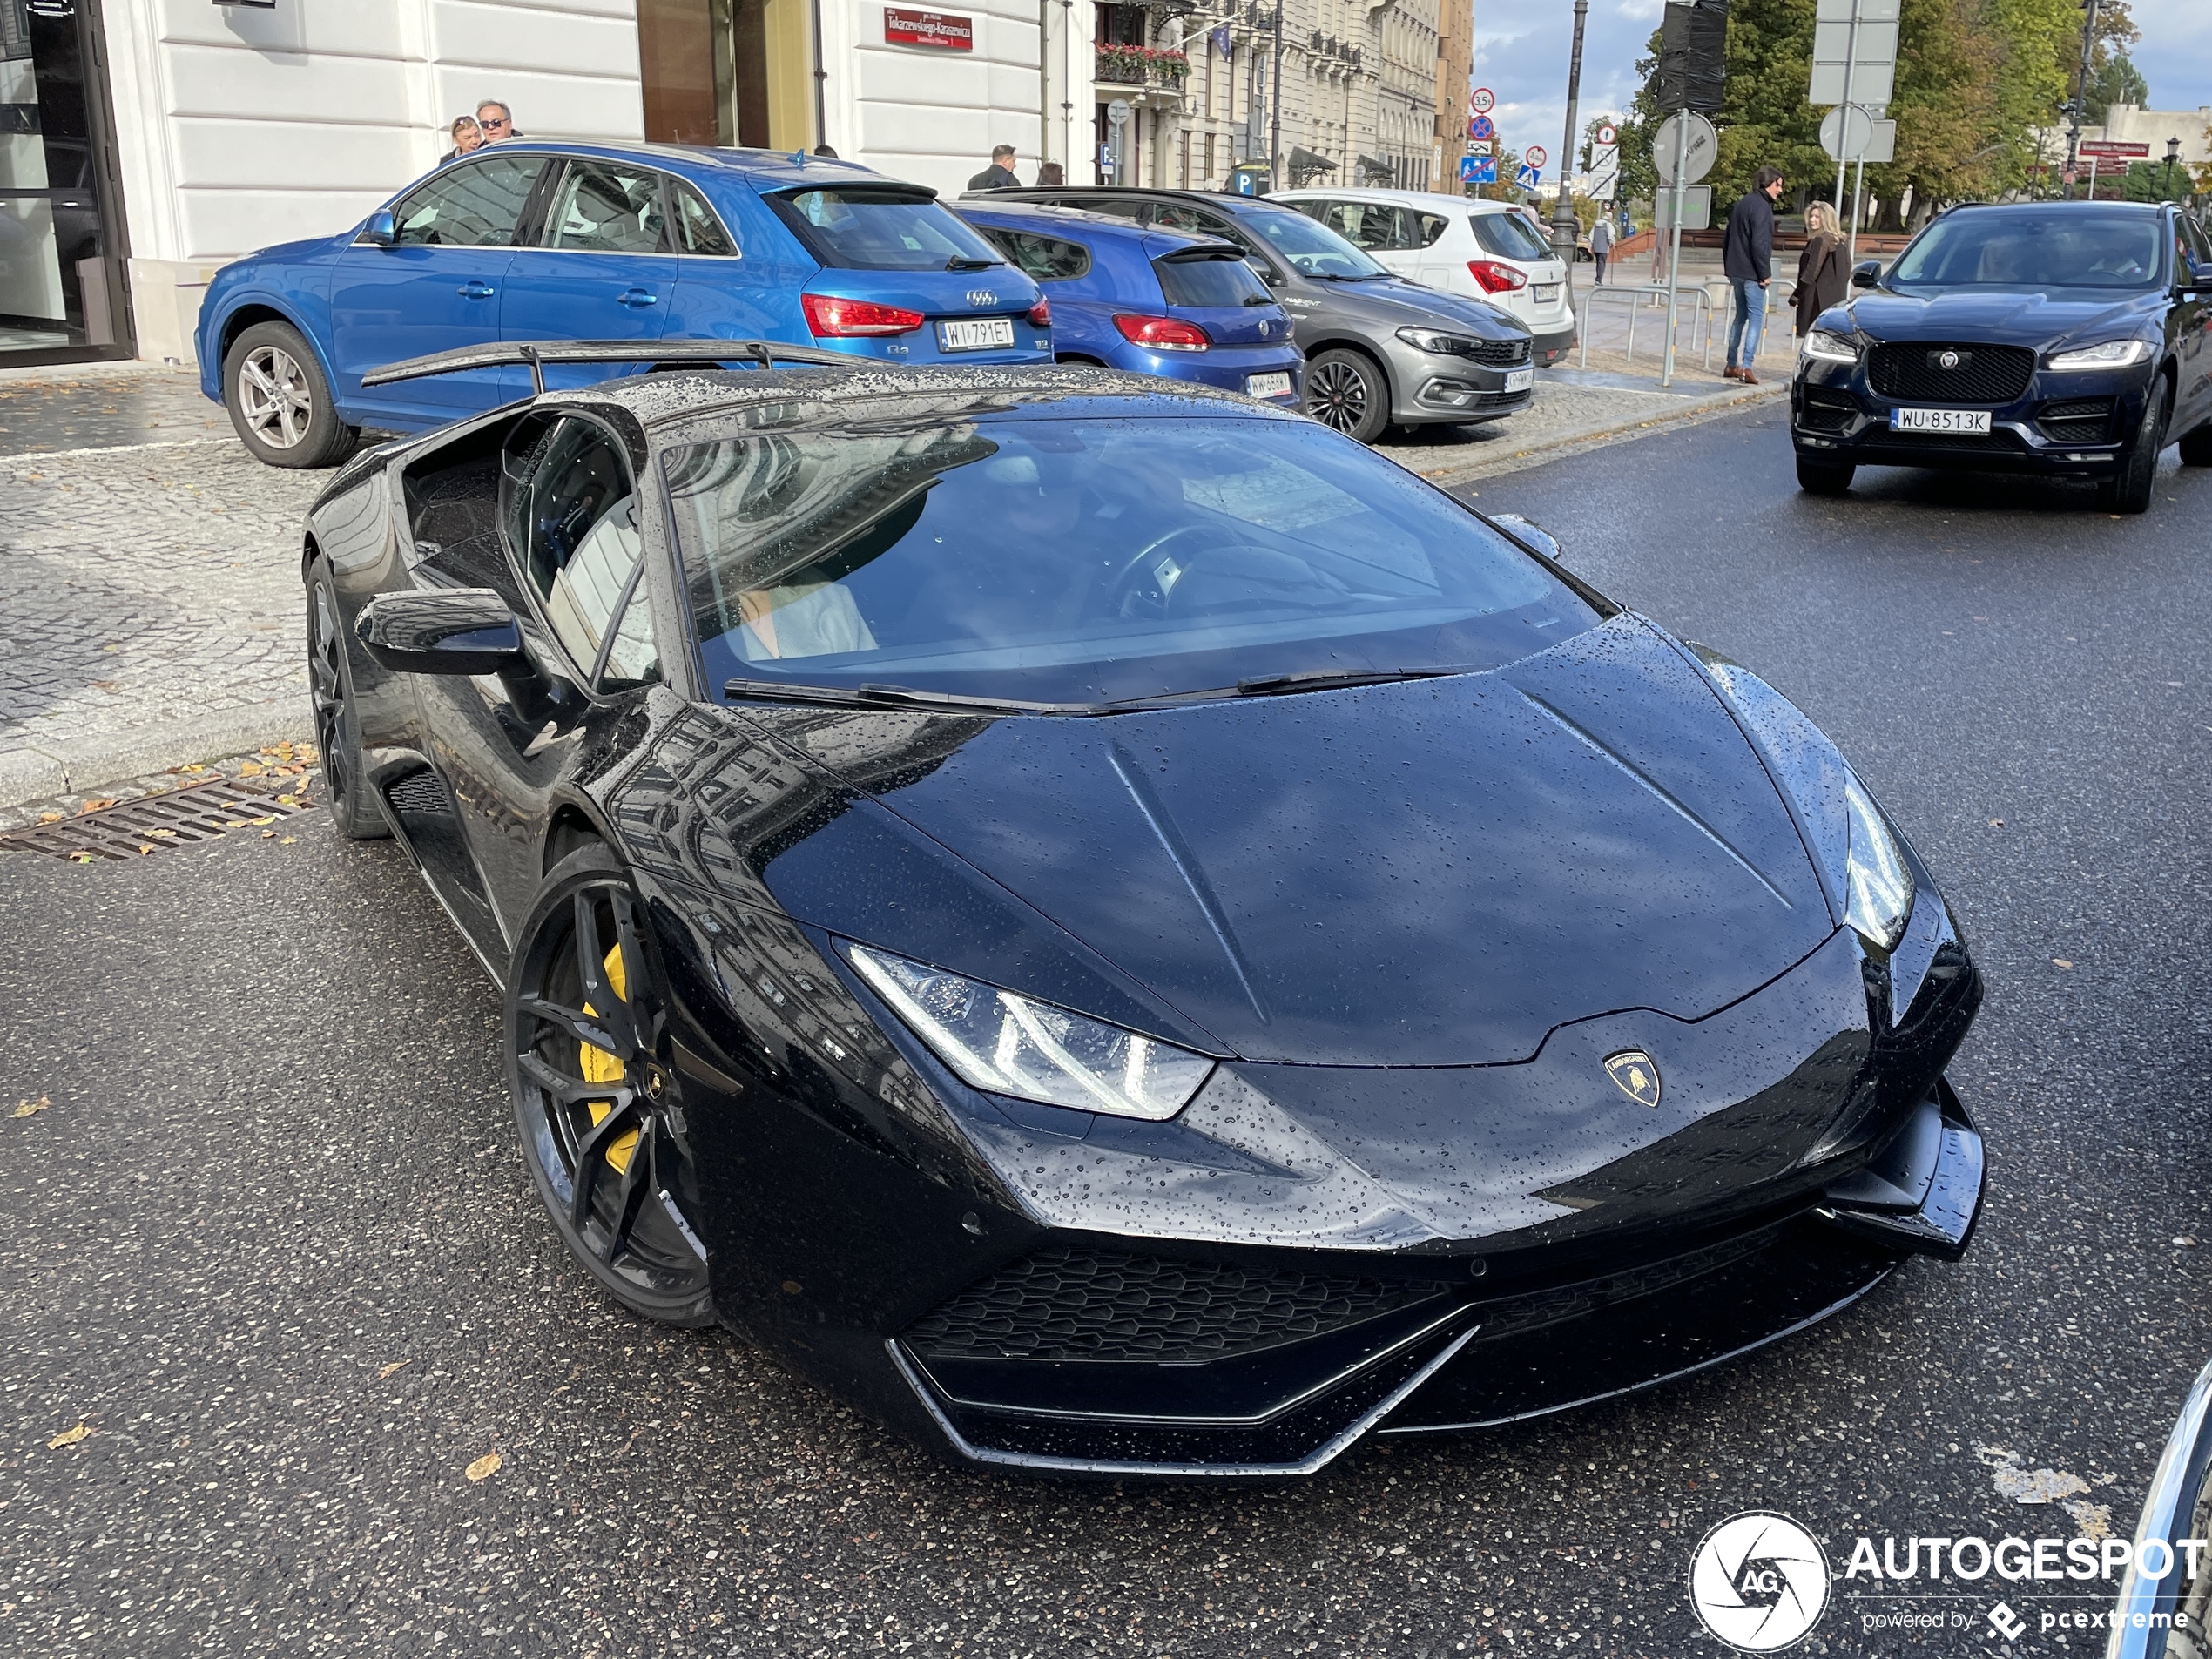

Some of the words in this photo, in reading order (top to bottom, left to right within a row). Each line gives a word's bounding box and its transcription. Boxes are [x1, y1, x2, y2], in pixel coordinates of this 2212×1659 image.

[1239, 174, 1251, 192] P
[972, 321, 1010, 343] 791ET
[1903, 410, 1925, 427] WU
[1931, 412, 1986, 430] 8513K
[1608, 1055, 1647, 1071] LAMBORGHINI
